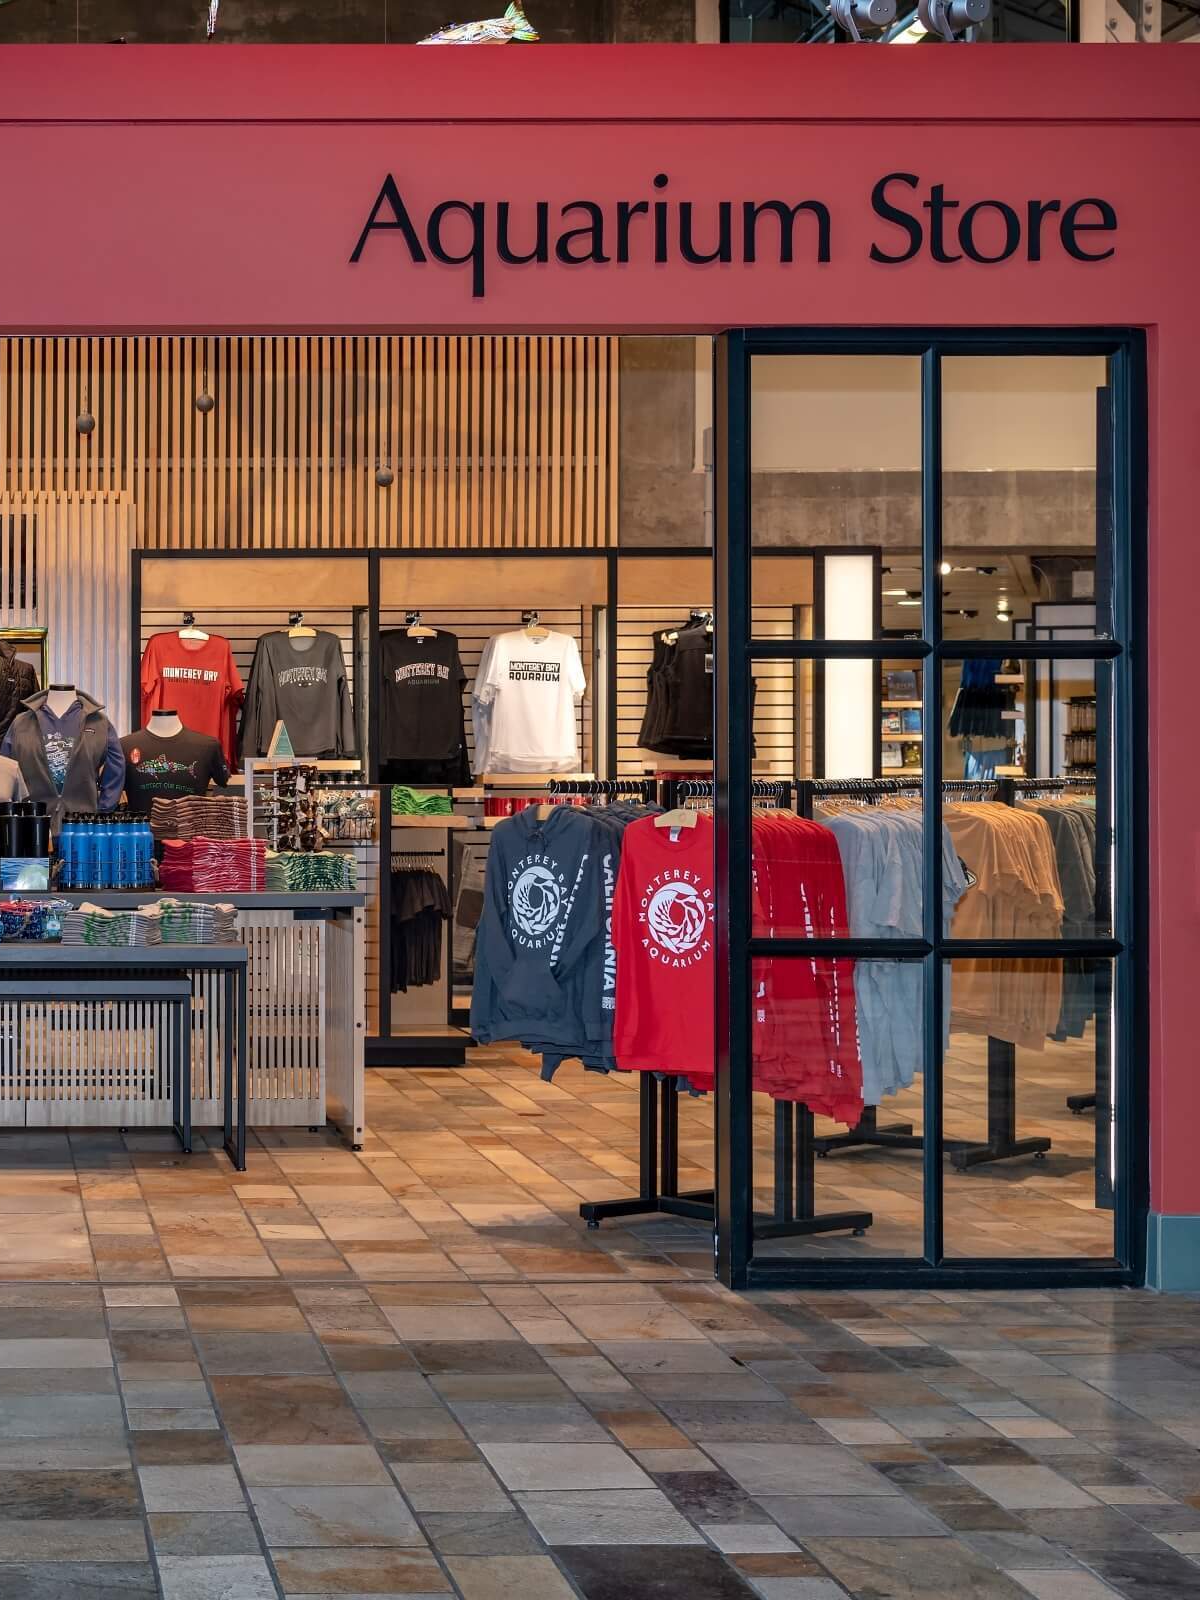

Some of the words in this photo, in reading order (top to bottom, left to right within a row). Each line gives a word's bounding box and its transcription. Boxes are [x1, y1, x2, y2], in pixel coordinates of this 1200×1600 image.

[349, 172, 832, 298] Aquarium
[869, 172, 1119, 264] Store
[509, 672, 560, 682] AQUARIUM
[510, 662, 545, 672] MONTEREY
[545, 663, 560, 672] BAY
[508, 854, 558, 904] ONTEREY
[638, 869, 701, 922] MONTEREY
[510, 918, 563, 949] QUARIUM
[641, 938, 711, 968] AQUARIUM
